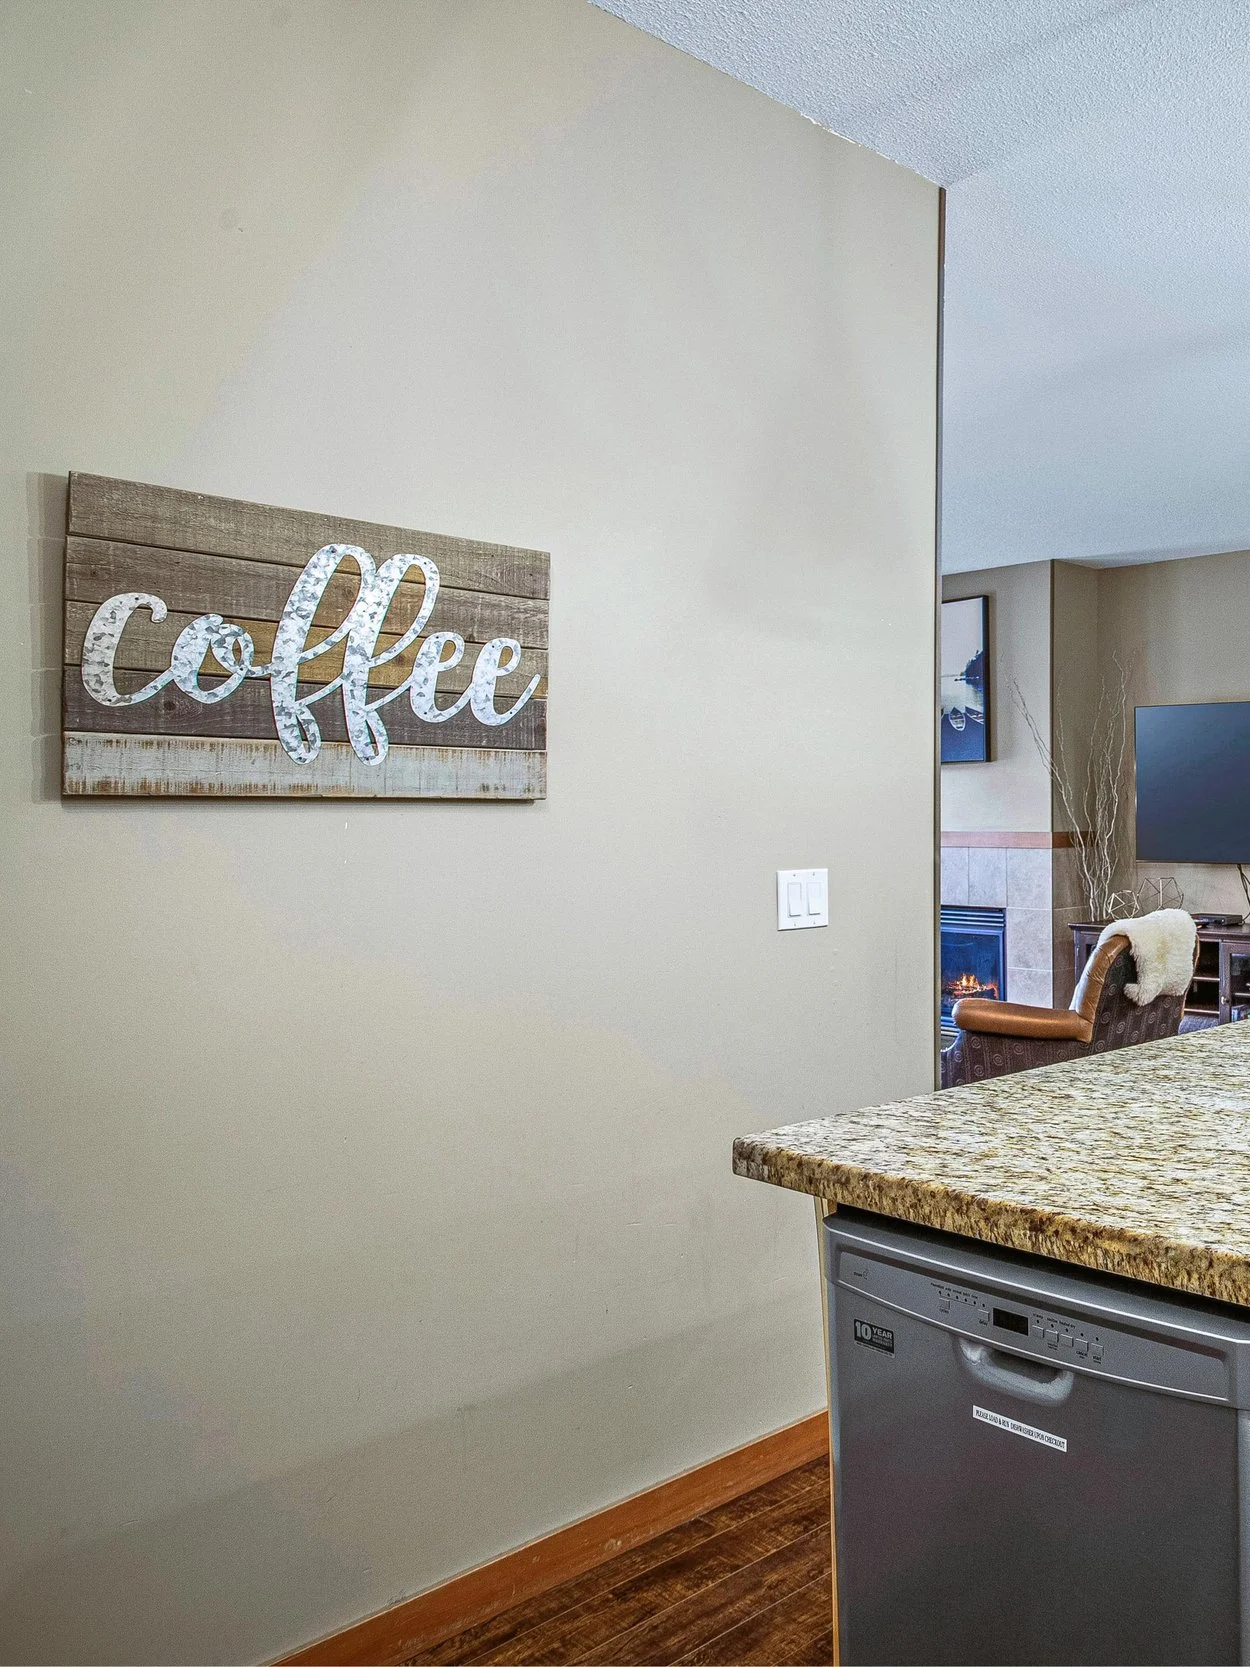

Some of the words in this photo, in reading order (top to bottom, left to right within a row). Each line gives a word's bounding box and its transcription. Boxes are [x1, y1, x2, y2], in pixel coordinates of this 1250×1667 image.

[81, 543, 541, 768] coffee
[855, 1321, 872, 1340] 10
[872, 1327, 893, 1340] YEAR
[1044, 1436, 1065, 1449] CHECKOUT
